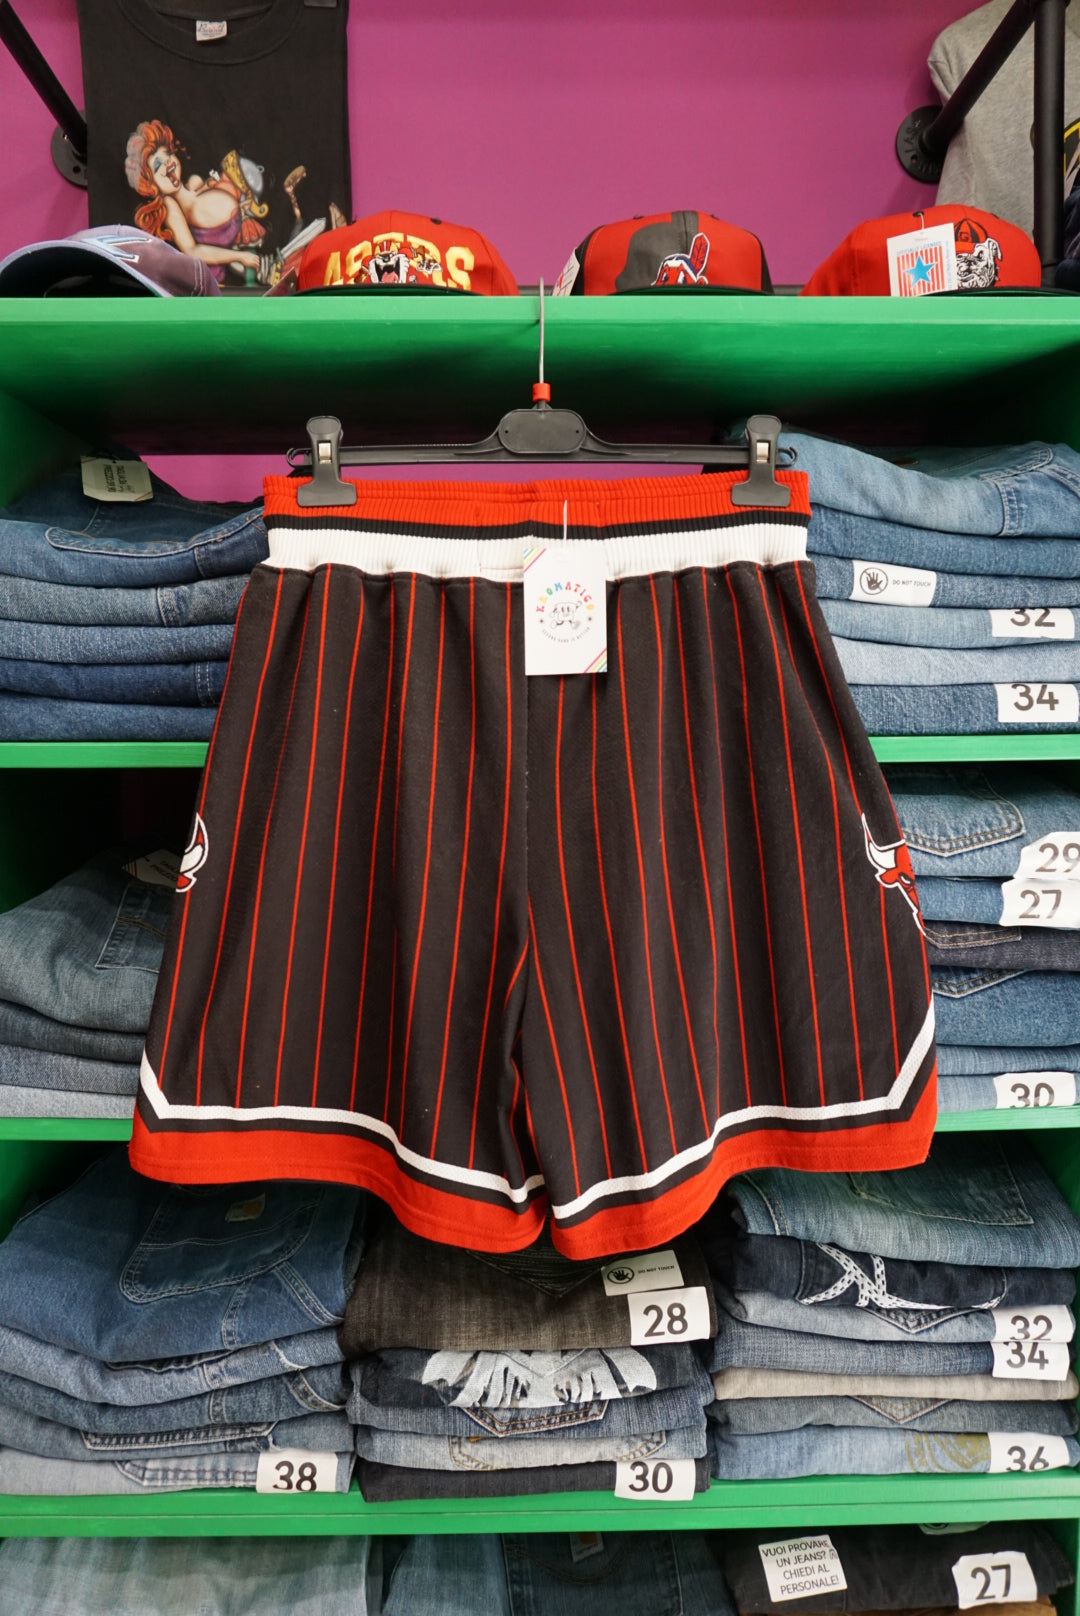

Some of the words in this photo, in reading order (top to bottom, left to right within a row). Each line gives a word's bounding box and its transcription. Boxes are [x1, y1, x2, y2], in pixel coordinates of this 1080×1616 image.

[959, 231, 970, 243] G
[913, 580, 932, 588] TOUCH
[1009, 608, 1056, 628] 32
[1010, 683, 1060, 712] 34
[1034, 842, 1080, 873] 29
[1018, 889, 1063, 919] 27
[1009, 1082, 1055, 1108] 30
[657, 1264, 675, 1272] TOUCH
[643, 1302, 689, 1338] 28
[1009, 1314, 1053, 1341] 32
[1003, 1341, 1049, 1371] 34
[1005, 1445, 1050, 1471] 36
[272, 1460, 318, 1492] 38
[628, 1461, 674, 1494] 30
[762, 1546, 786, 1558] VUOI
[776, 1557, 791, 1568] UN
[793, 1550, 827, 1565] JEANS?
[783, 1566, 815, 1580] CHIEDI
[817, 1563, 831, 1574] AL
[970, 1563, 1011, 1601] 27
[780, 1575, 840, 1595] PERSONALE!
